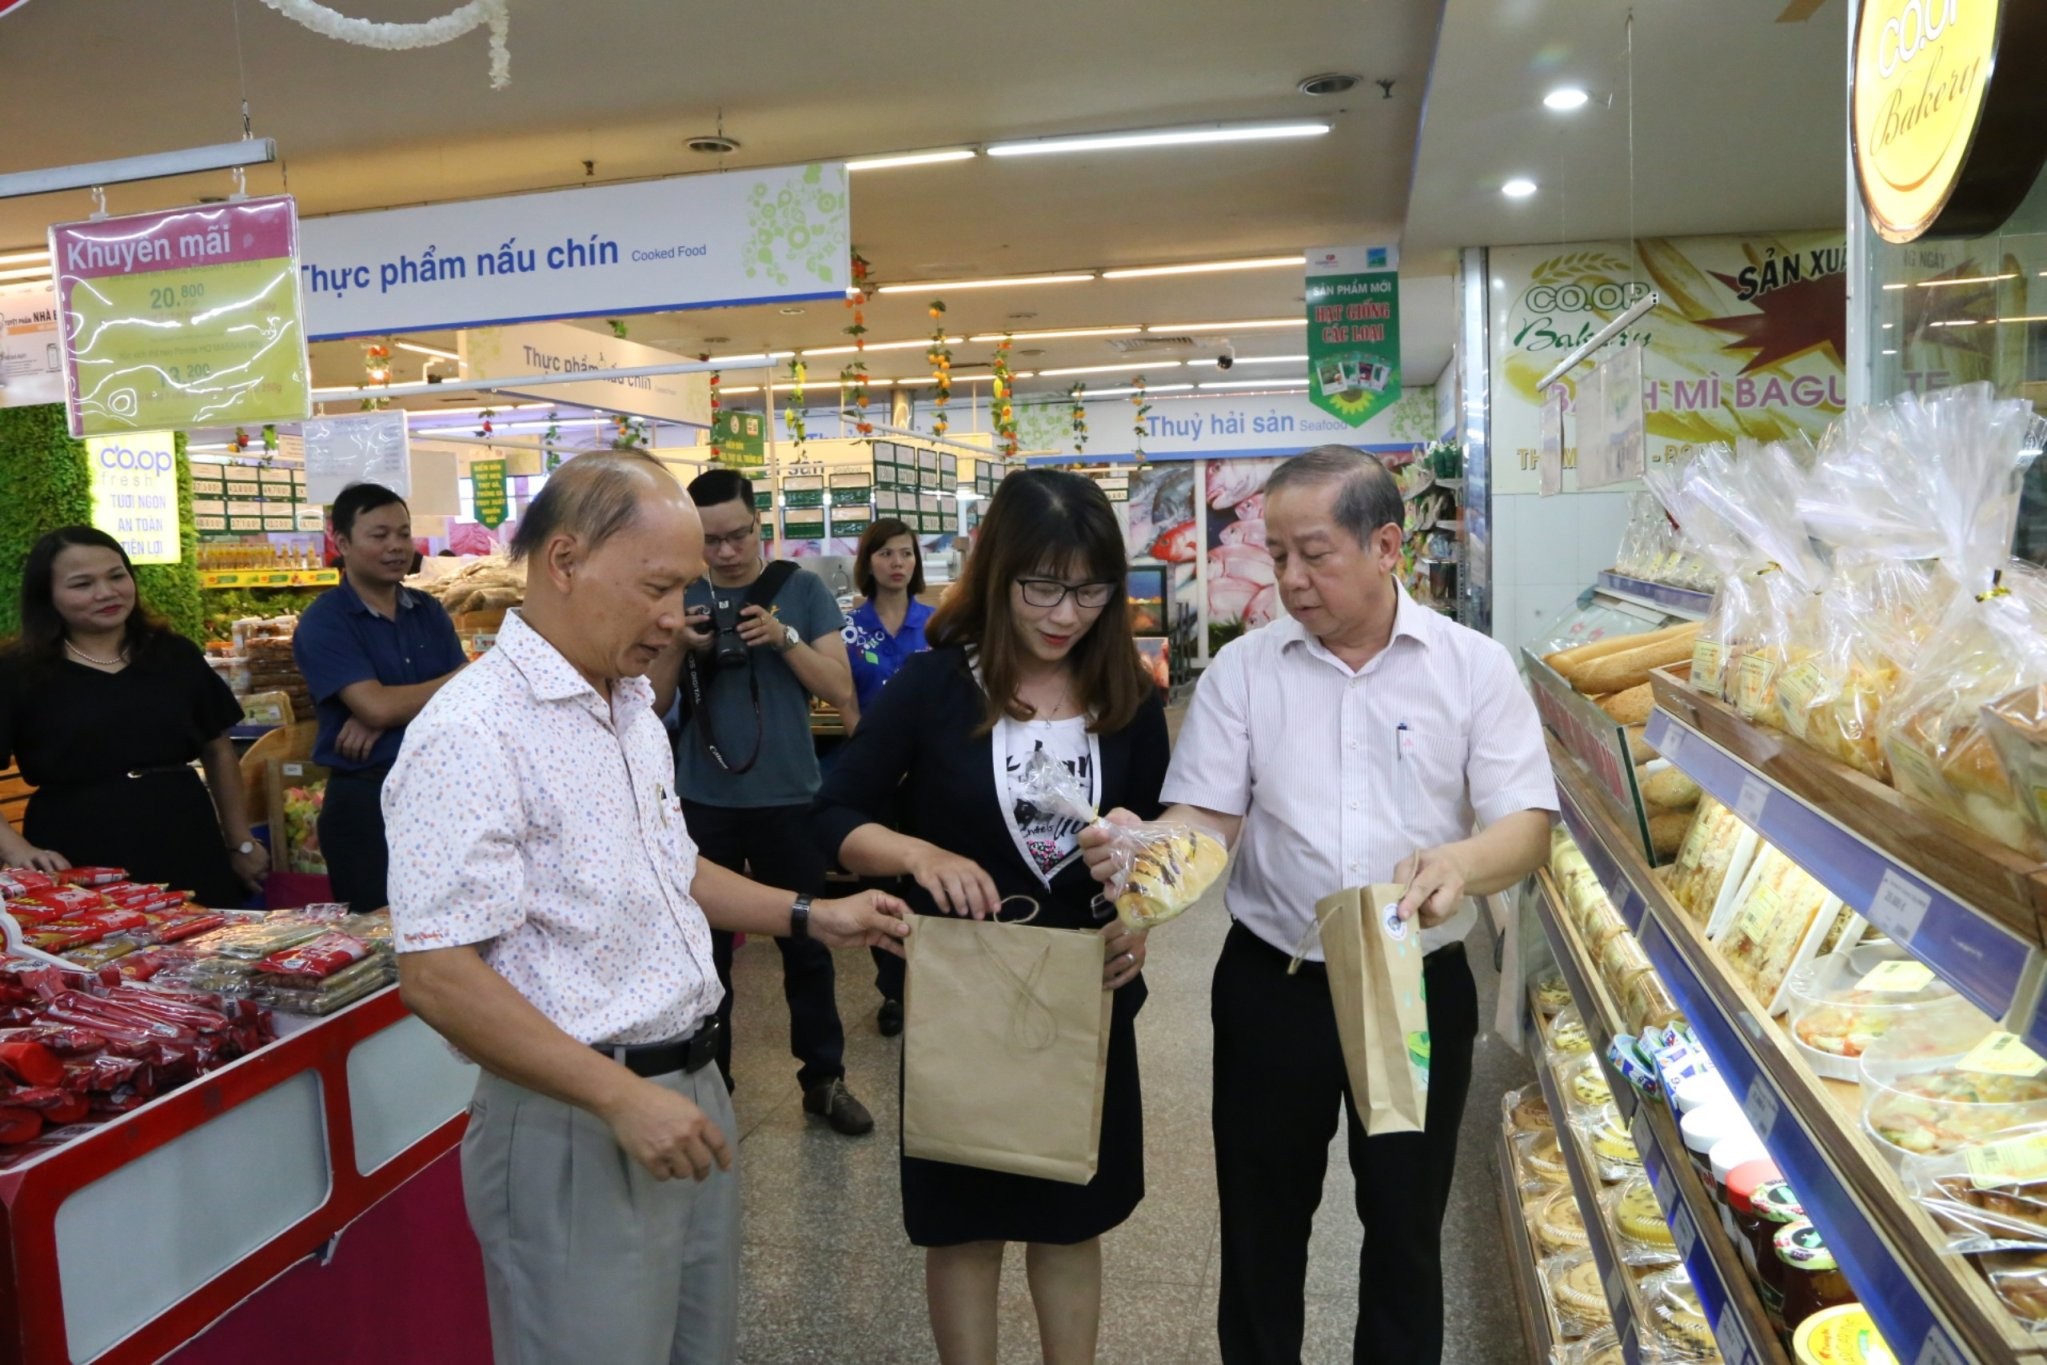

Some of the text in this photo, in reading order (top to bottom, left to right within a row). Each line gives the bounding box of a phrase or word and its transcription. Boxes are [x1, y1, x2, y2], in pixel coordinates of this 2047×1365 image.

[1870, 46, 1981, 157] Bakery
[180, 225, 231, 257] mãi
[381, 245, 466, 293] phẩm
[477, 237, 535, 276] nấu
[547, 235, 618, 269] chín
[632, 247, 675, 261] Cooked
[678, 244, 707, 257] Food
[1737, 247, 1800, 301] SẢN
[1312, 278, 1392, 296] SẢN PHẨM MỚI
[1526, 282, 1651, 314] CO.OP
[1315, 298, 1391, 323] HẠT GIỐNG
[1322, 322, 1385, 344] CÁC LOẠI
[523, 345, 561, 374] Thực
[1675, 371, 1719, 409] MÌ
[1146, 409, 1347, 441] Thuỷ hải sản Seafood
[102, 471, 153, 487] fresh
[138, 495, 166, 509] NGON
[118, 515, 163, 532] AN TOÀN
